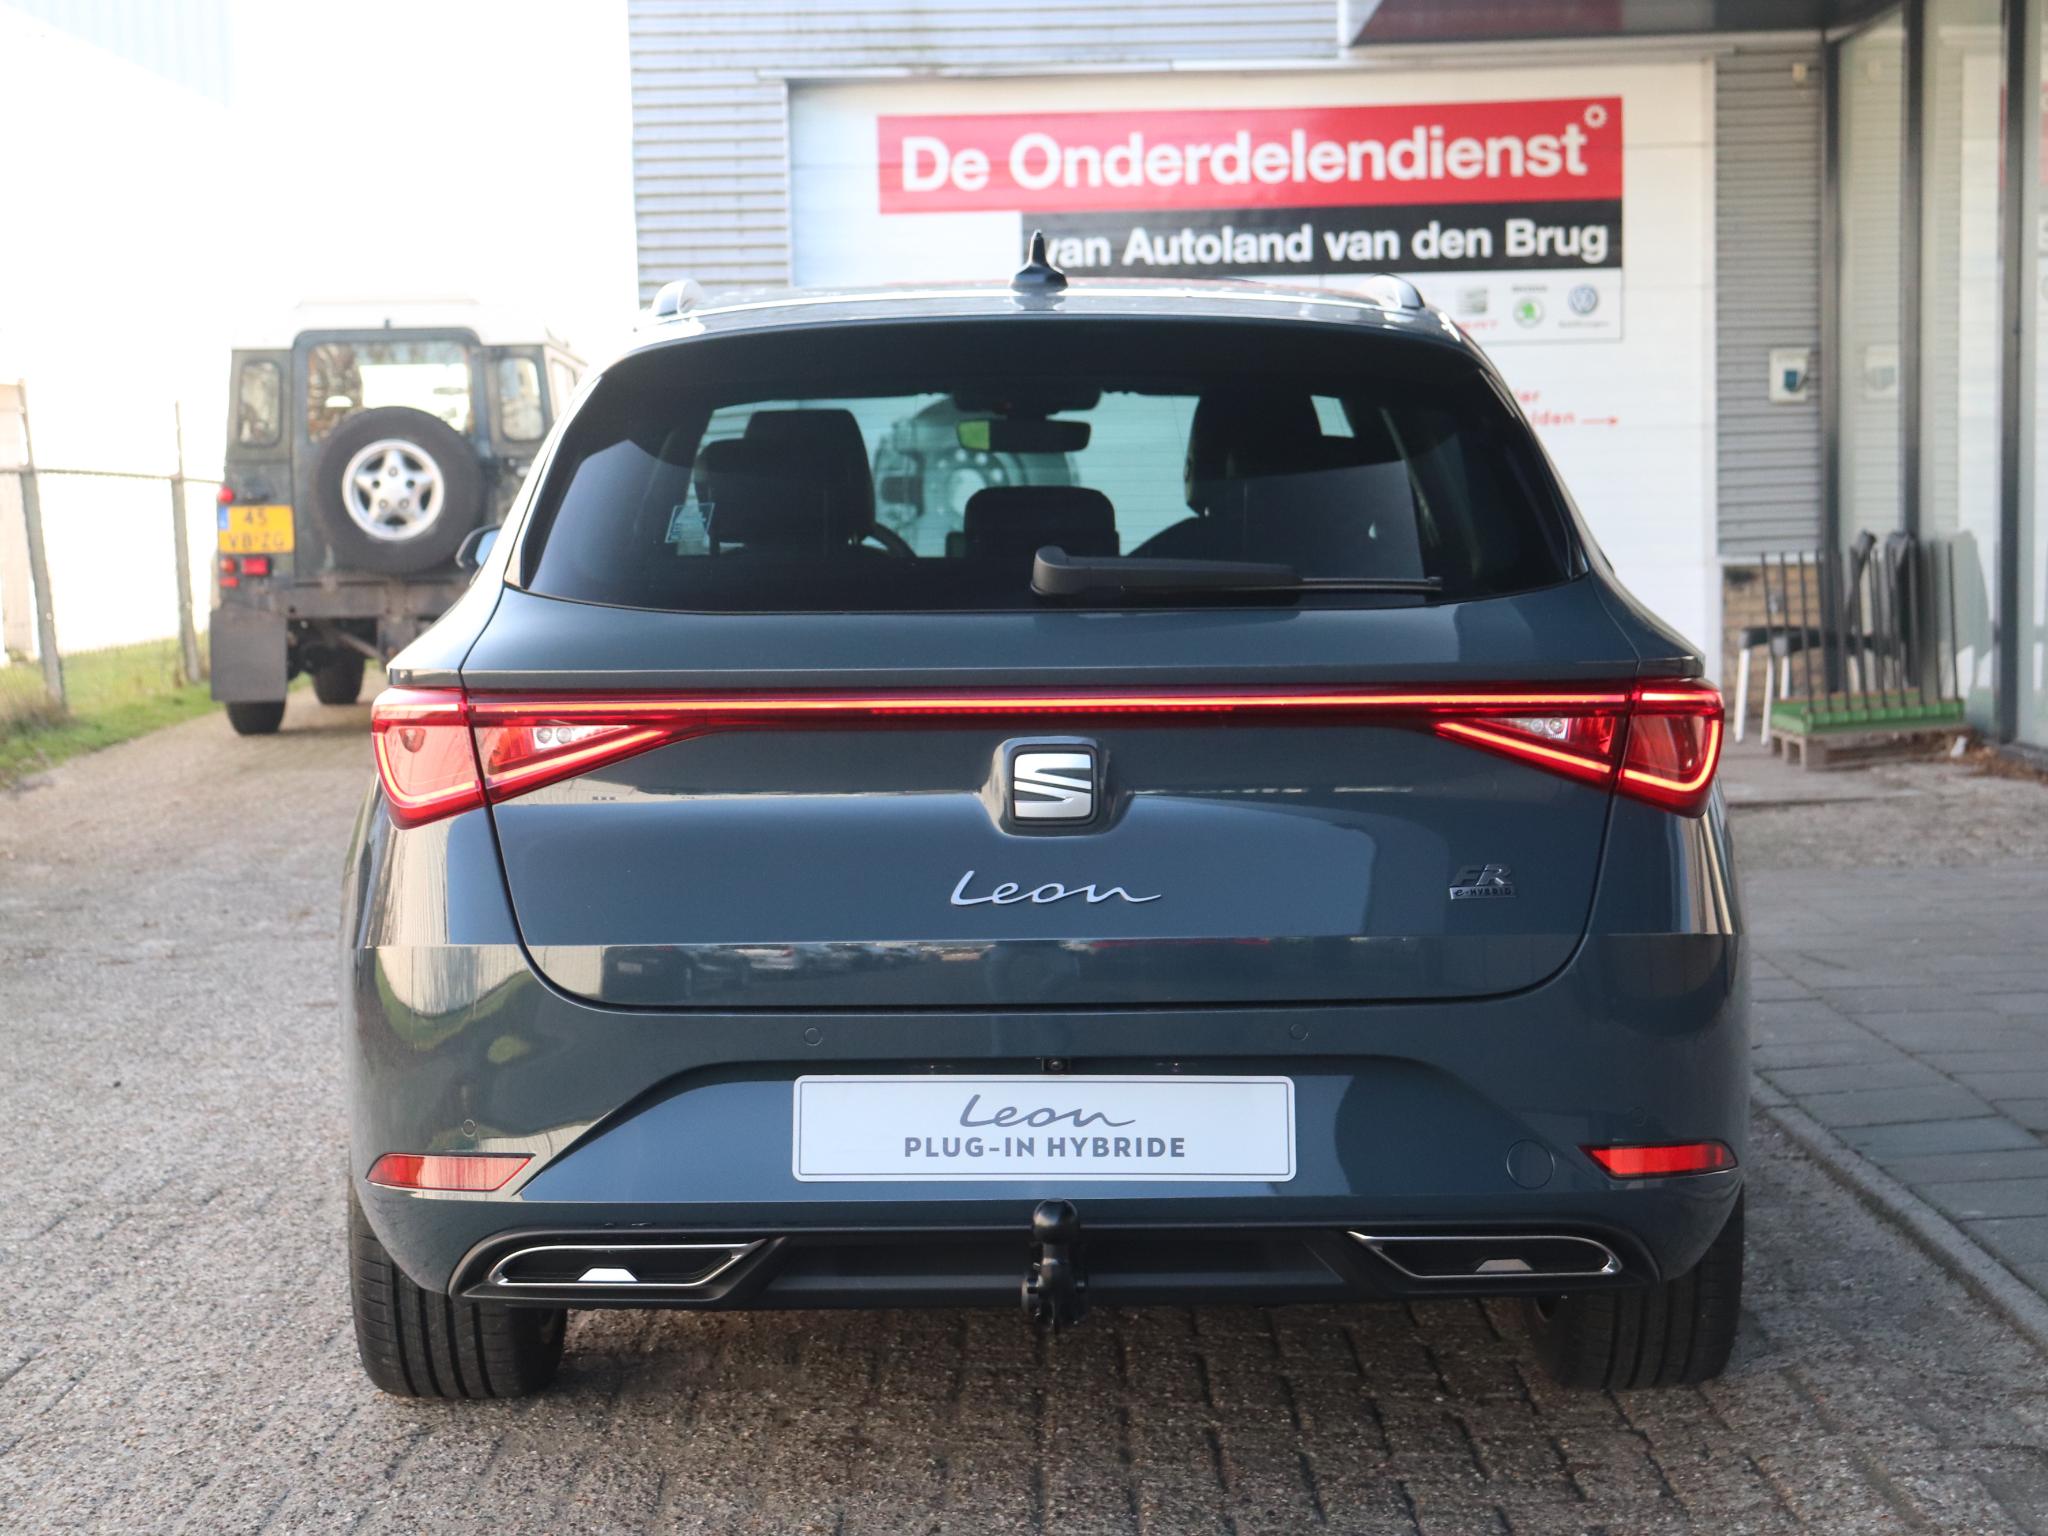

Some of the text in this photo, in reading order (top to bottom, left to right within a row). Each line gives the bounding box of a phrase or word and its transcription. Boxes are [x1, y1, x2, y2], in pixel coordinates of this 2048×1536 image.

[901, 124, 1589, 191] De Onderdelendienst
[1122, 224, 1313, 264] Autoland
[1324, 229, 1401, 259] van
[1411, 221, 1493, 258] den
[1505, 219, 1609, 264] Brug
[950, 870, 1161, 906] Leon
[959, 1093, 1136, 1128] Leon
[904, 1137, 1186, 1158] PLUG-IN HYBRIDE
